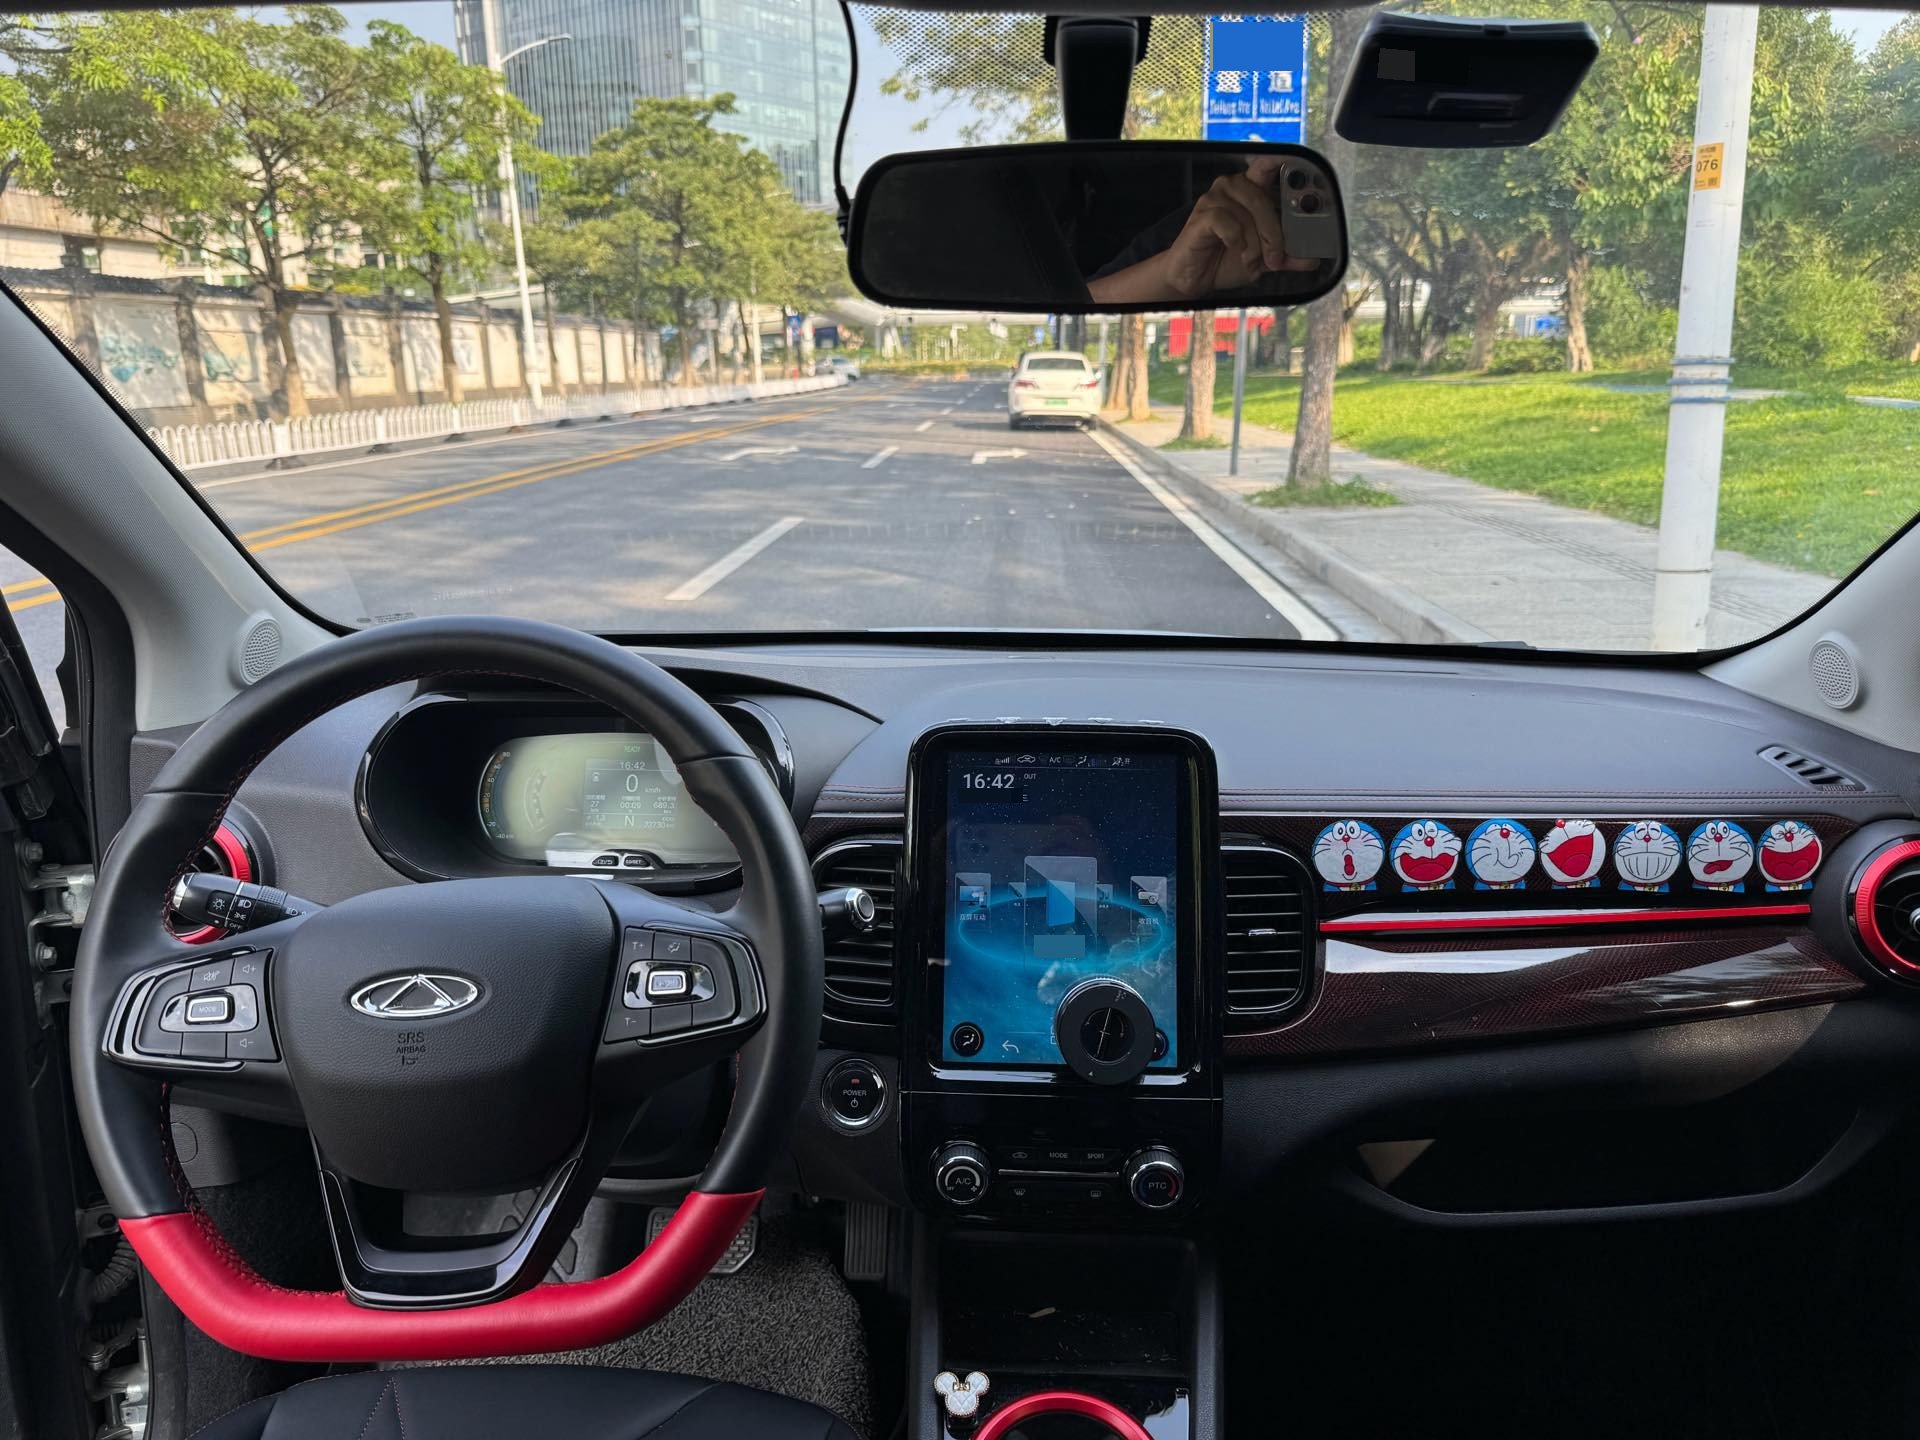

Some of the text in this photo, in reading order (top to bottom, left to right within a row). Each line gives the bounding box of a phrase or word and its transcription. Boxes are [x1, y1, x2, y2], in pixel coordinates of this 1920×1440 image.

[1696, 159, 1719, 172] 076
[620, 761, 646, 769] 16:42
[626, 774, 639, 793] 0
[963, 773, 1015, 789] 16:42
[624, 815, 635, 827] N
[398, 1032, 425, 1044] SRS
[396, 1045, 426, 1054] AIRBAG
[1148, 1181, 1167, 1190] PTC
